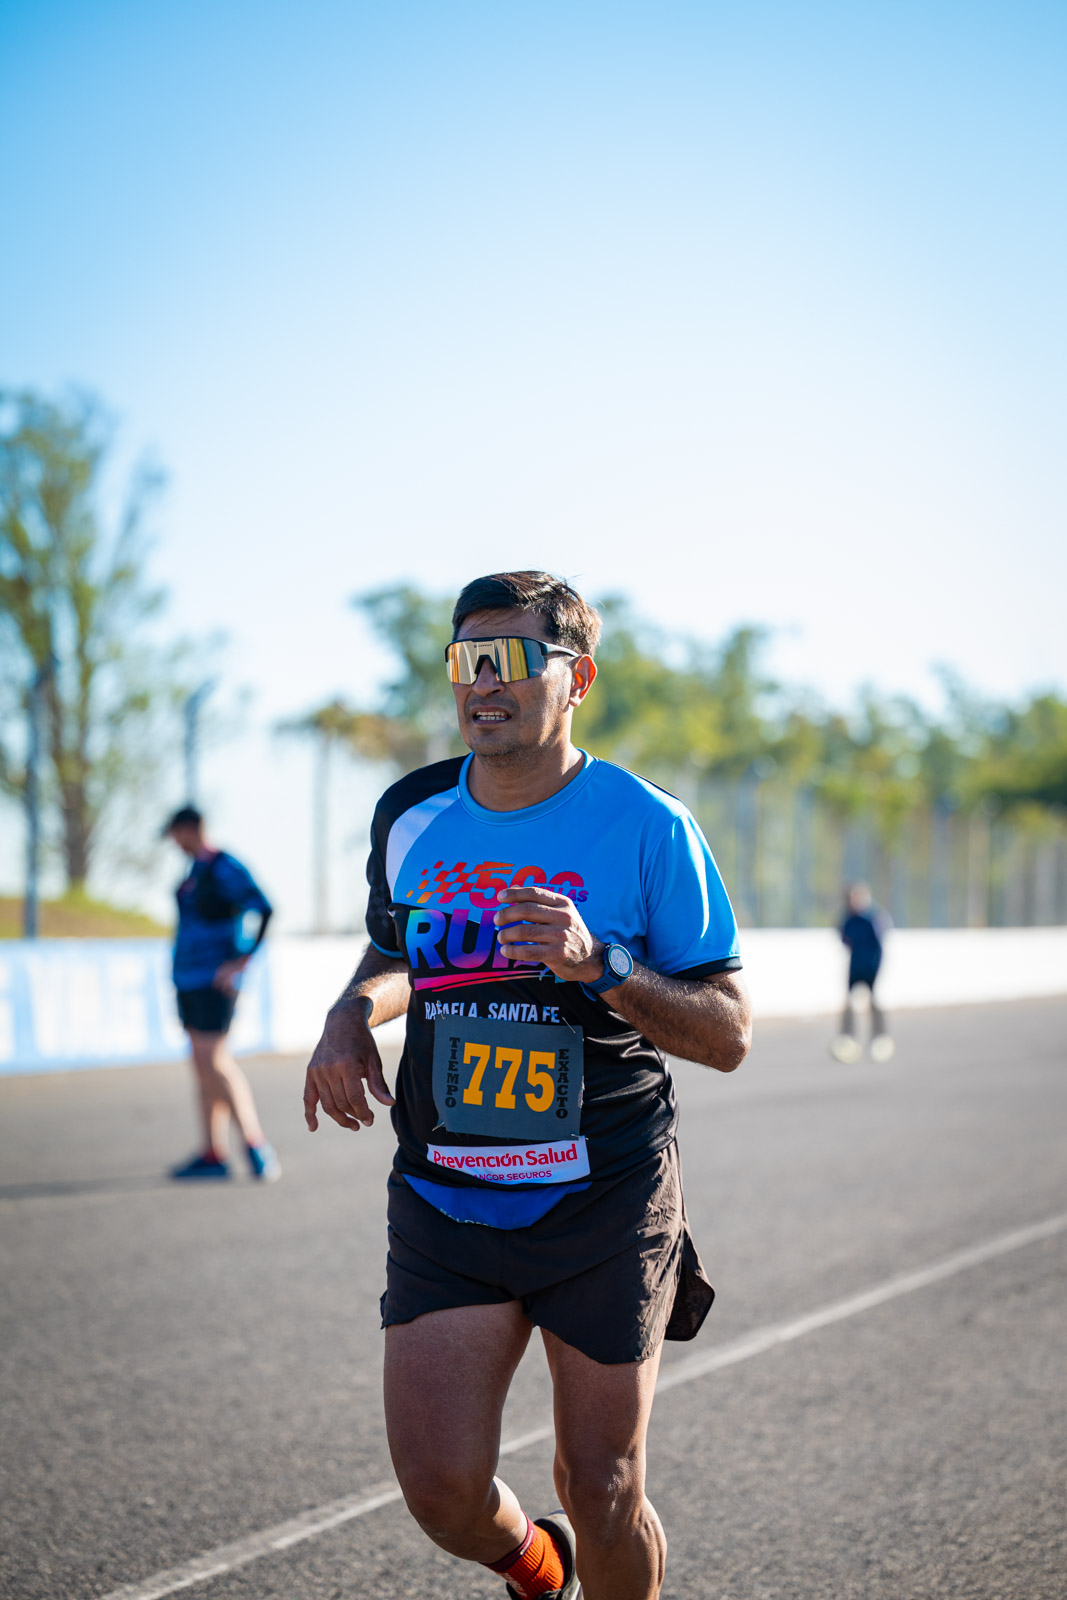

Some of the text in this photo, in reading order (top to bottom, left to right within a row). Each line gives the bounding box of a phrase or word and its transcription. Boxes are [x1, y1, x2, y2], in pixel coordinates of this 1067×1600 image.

[488, 1002, 538, 1022] SANTA
[542, 1006, 560, 1023] FE
[445, 1037, 460, 1108] TIEMPO
[463, 1042, 556, 1112] 775
[556, 1049, 569, 1119] EXACTO
[433, 1143, 577, 1169] Prevención Salud
[506, 1170, 552, 1181] SEGUROS
